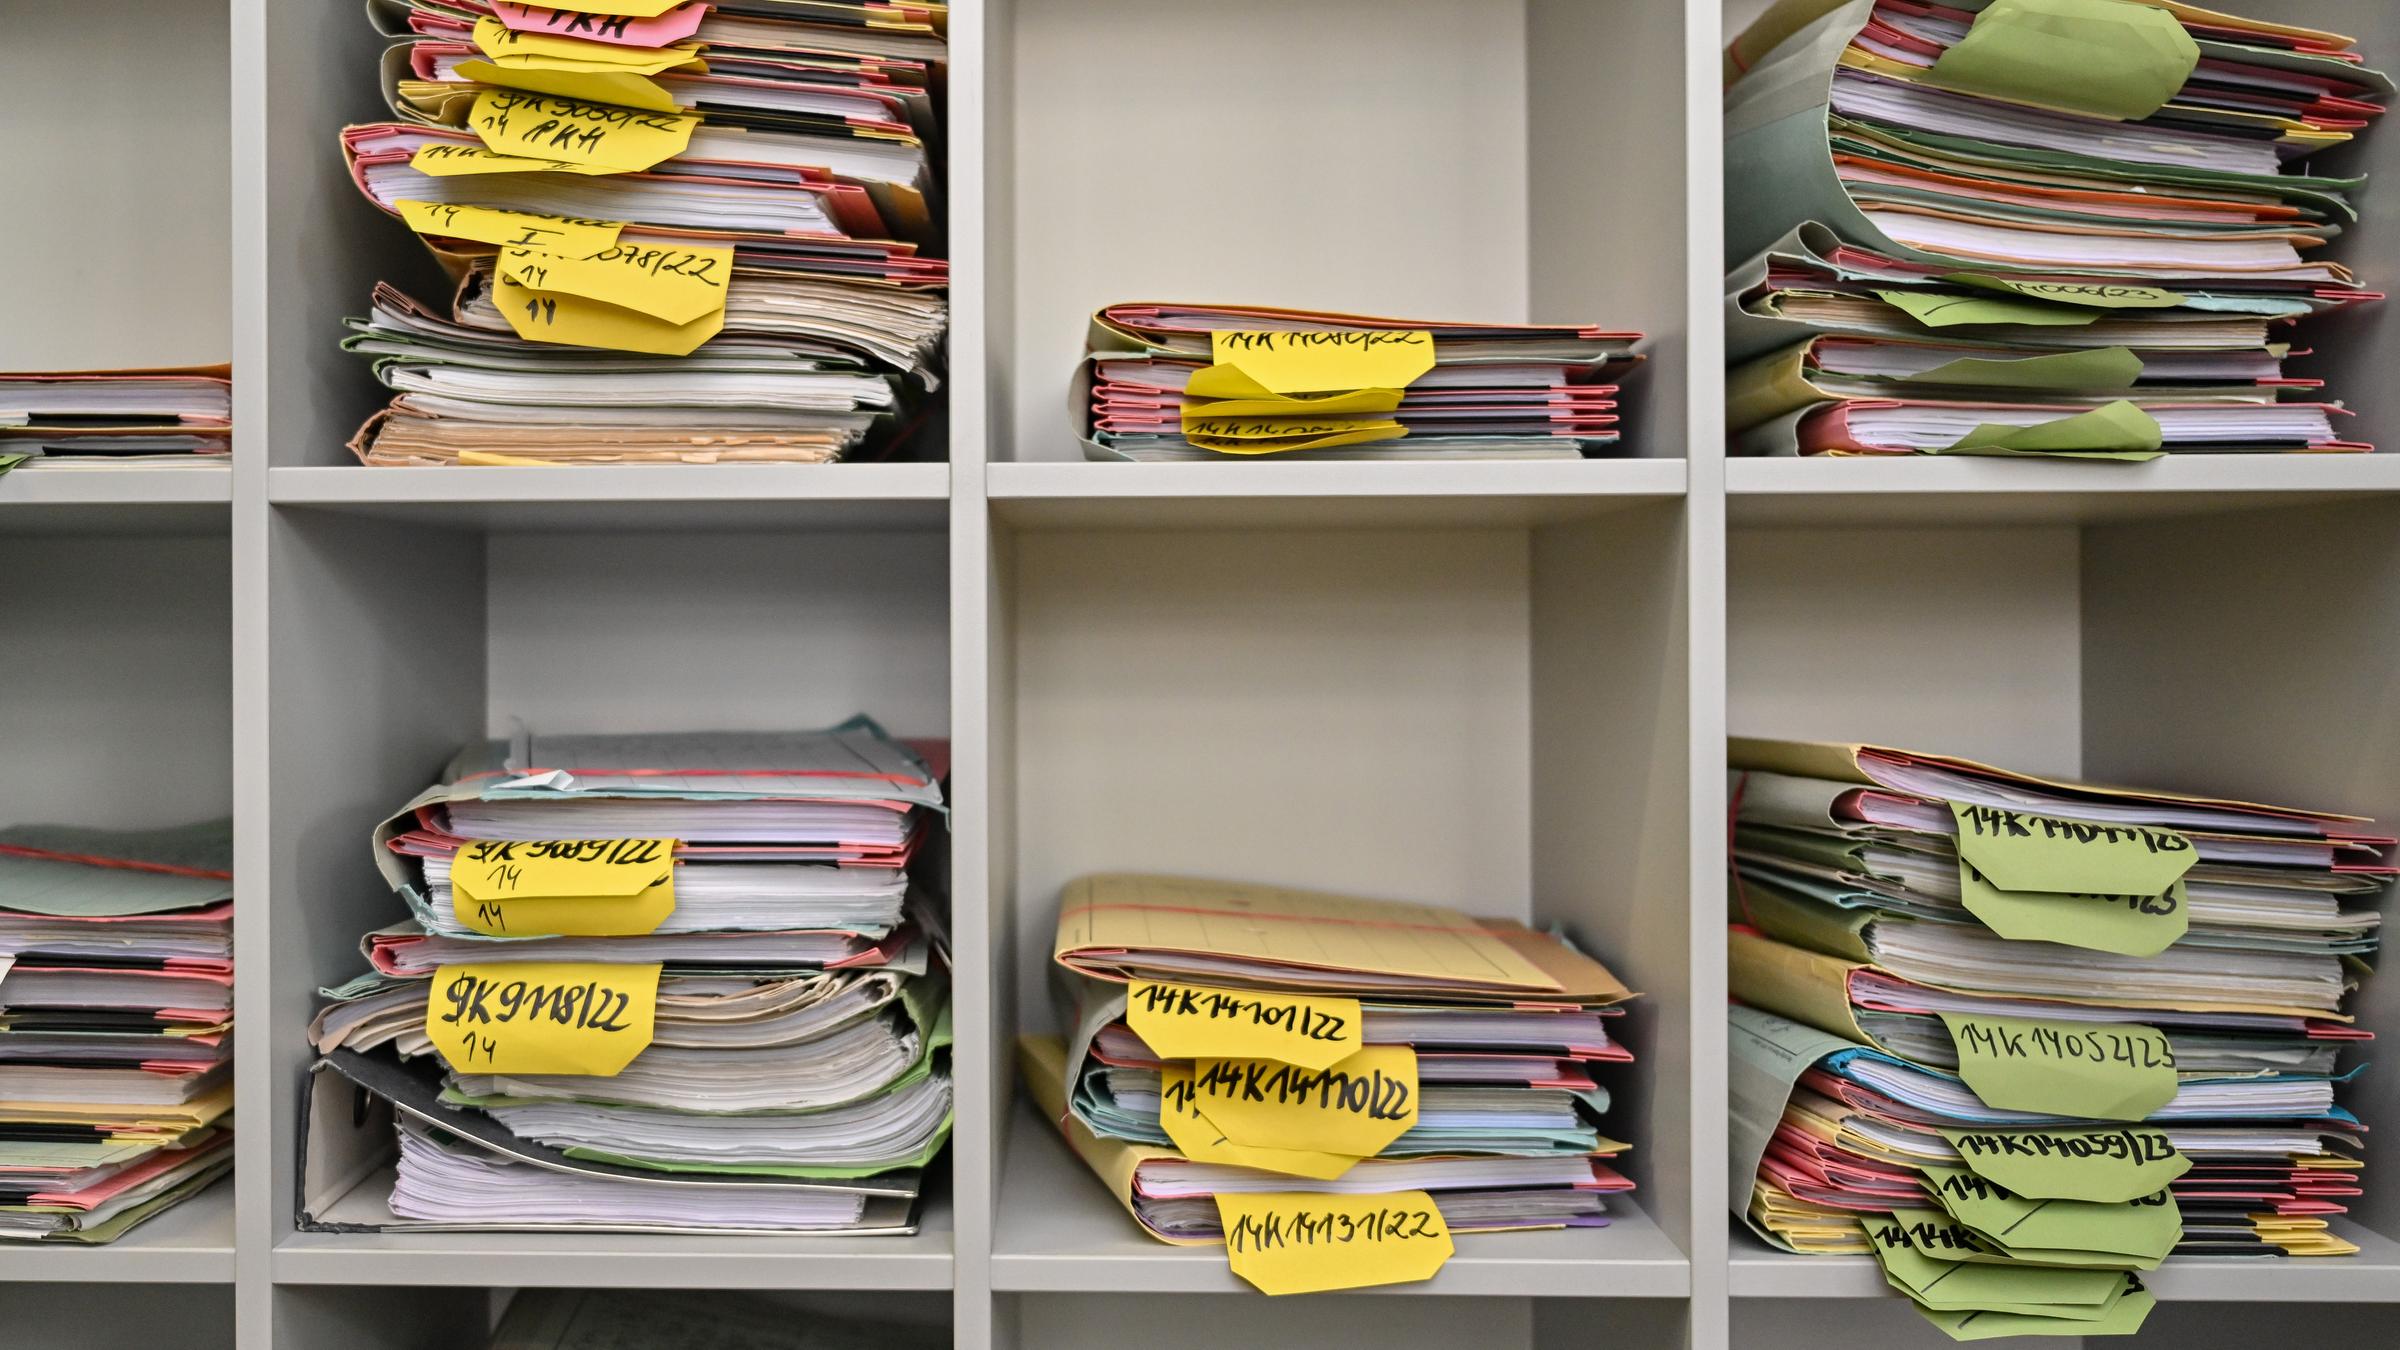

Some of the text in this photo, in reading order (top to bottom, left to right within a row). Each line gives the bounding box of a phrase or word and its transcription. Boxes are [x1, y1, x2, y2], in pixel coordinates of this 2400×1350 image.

[482, 114, 507, 136] 14
[519, 265, 547, 287] 14
[525, 297, 557, 326] 14
[487, 864, 523, 891] 14
[478, 900, 506, 932] 14
[462, 1031, 497, 1064] 14
